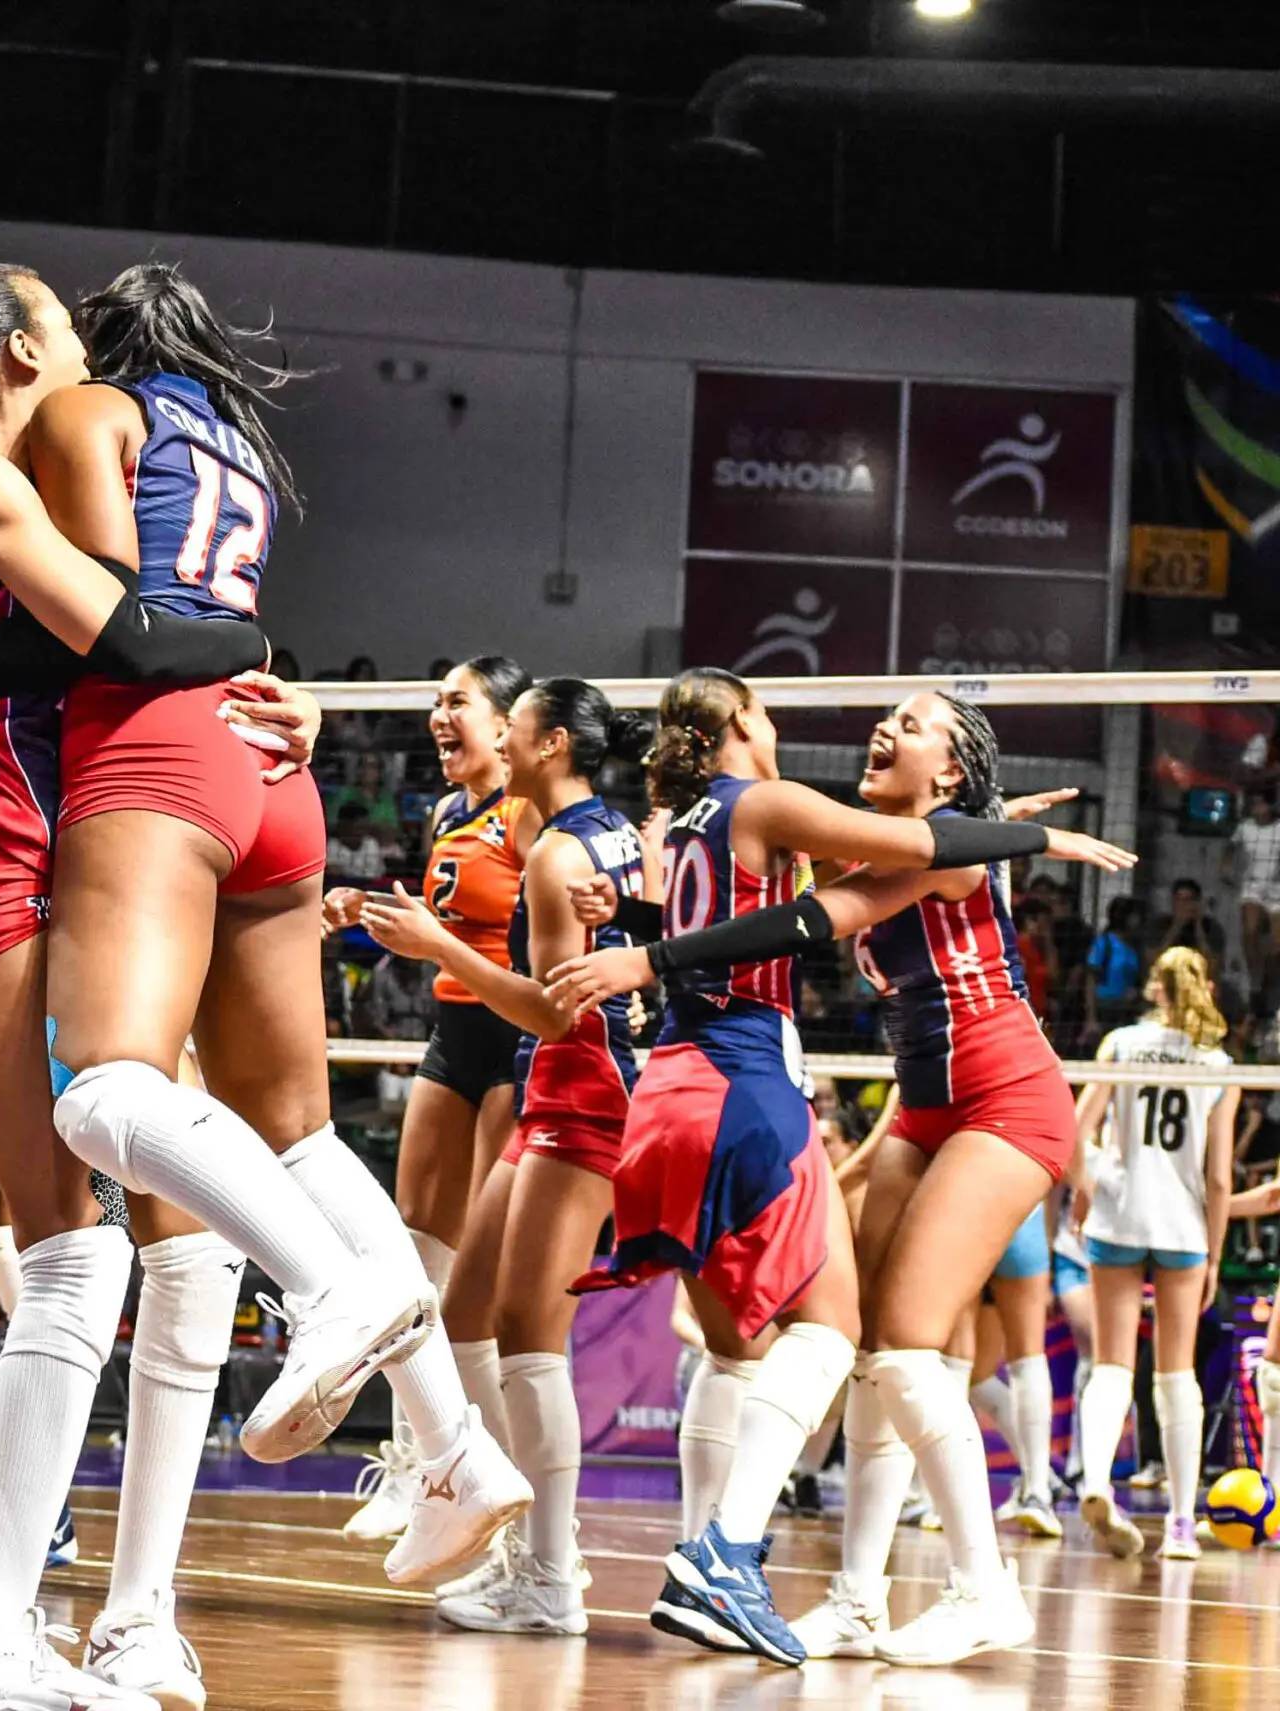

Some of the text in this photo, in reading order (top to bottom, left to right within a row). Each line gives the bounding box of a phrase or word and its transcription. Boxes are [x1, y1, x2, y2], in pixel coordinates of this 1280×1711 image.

[713, 457, 876, 492] SONORA
[175, 441, 260, 617] 12
[952, 515, 1069, 539] CODESON
[1142, 551, 1210, 593] 203
[431, 859, 464, 921] 2
[1137, 1085, 1188, 1152] 18
